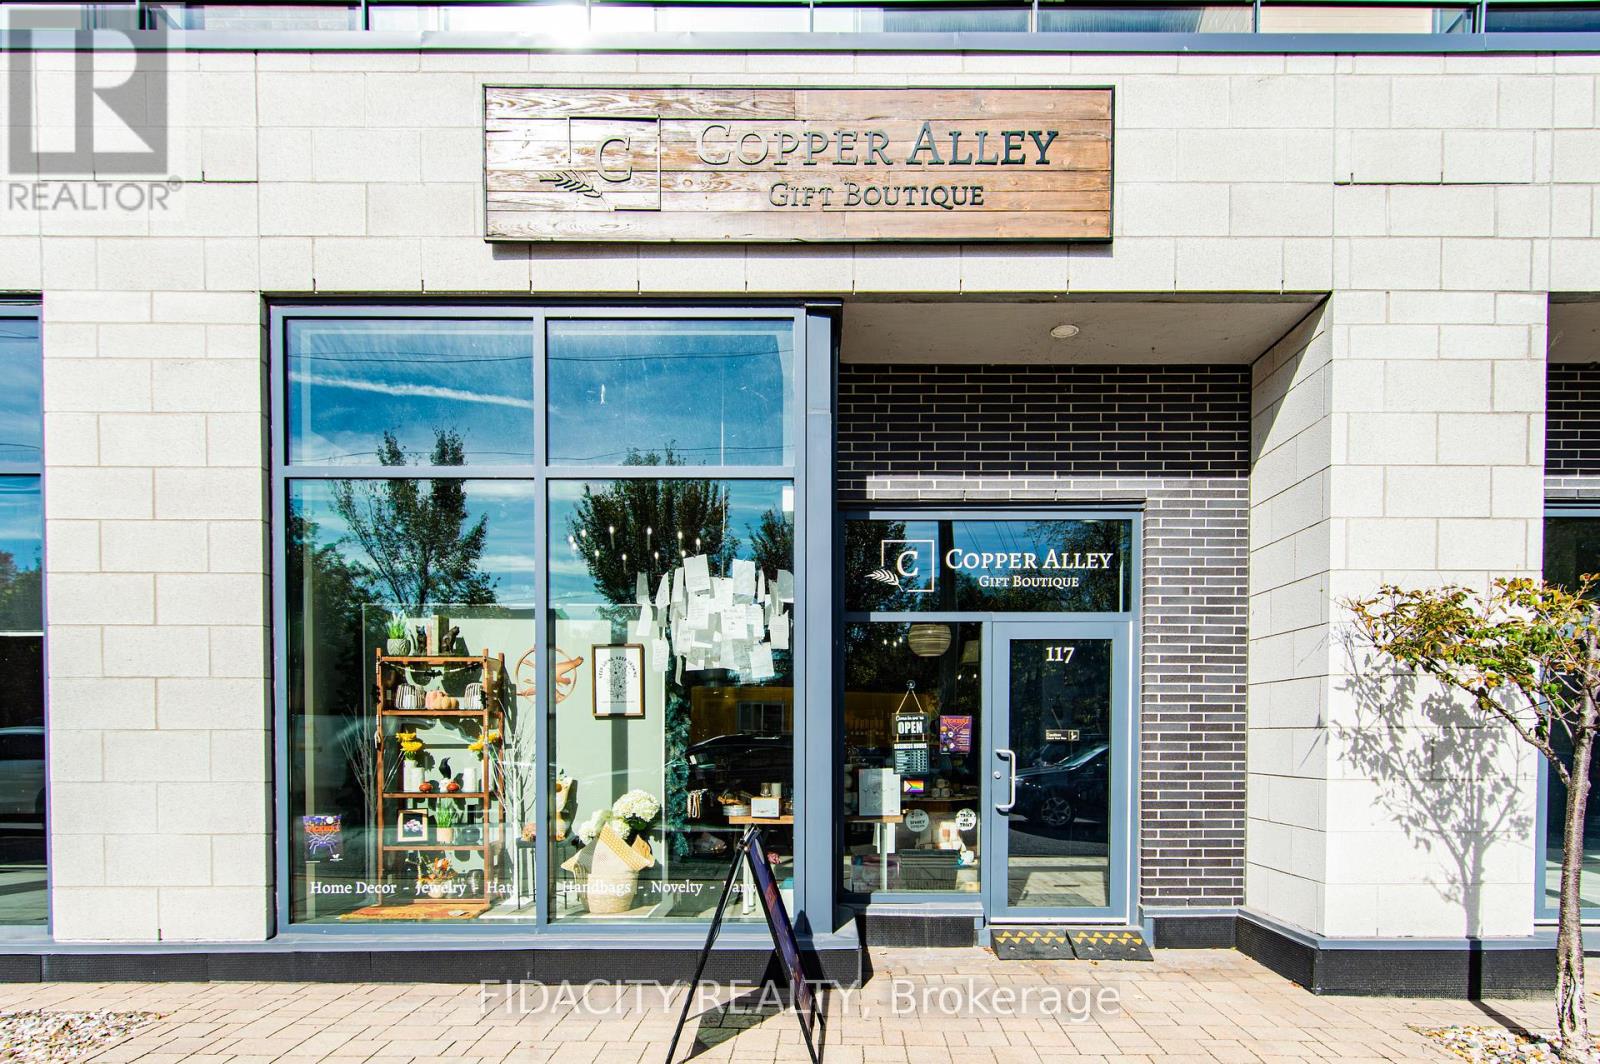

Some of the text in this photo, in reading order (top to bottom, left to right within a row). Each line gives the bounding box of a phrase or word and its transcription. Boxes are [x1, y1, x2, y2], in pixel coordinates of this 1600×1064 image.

[697, 121, 1060, 167] COPPER ALLEY
[596, 135, 633, 183] C
[768, 182, 985, 211] GIFT BOUTIQUE
[896, 550, 919, 577] C
[945, 548, 1114, 570] COPPER ALLEY
[978, 575, 1080, 590] GIFT BOUTIQUE
[1045, 647, 1076, 664] 117
[897, 721, 923, 734] OPEN
[310, 881, 352, 894] Home
[355, 881, 397, 894] Decor
[415, 881, 467, 897] Jewelry
[563, 880, 631, 897] Handbags
[651, 880, 704, 897] Novelty
